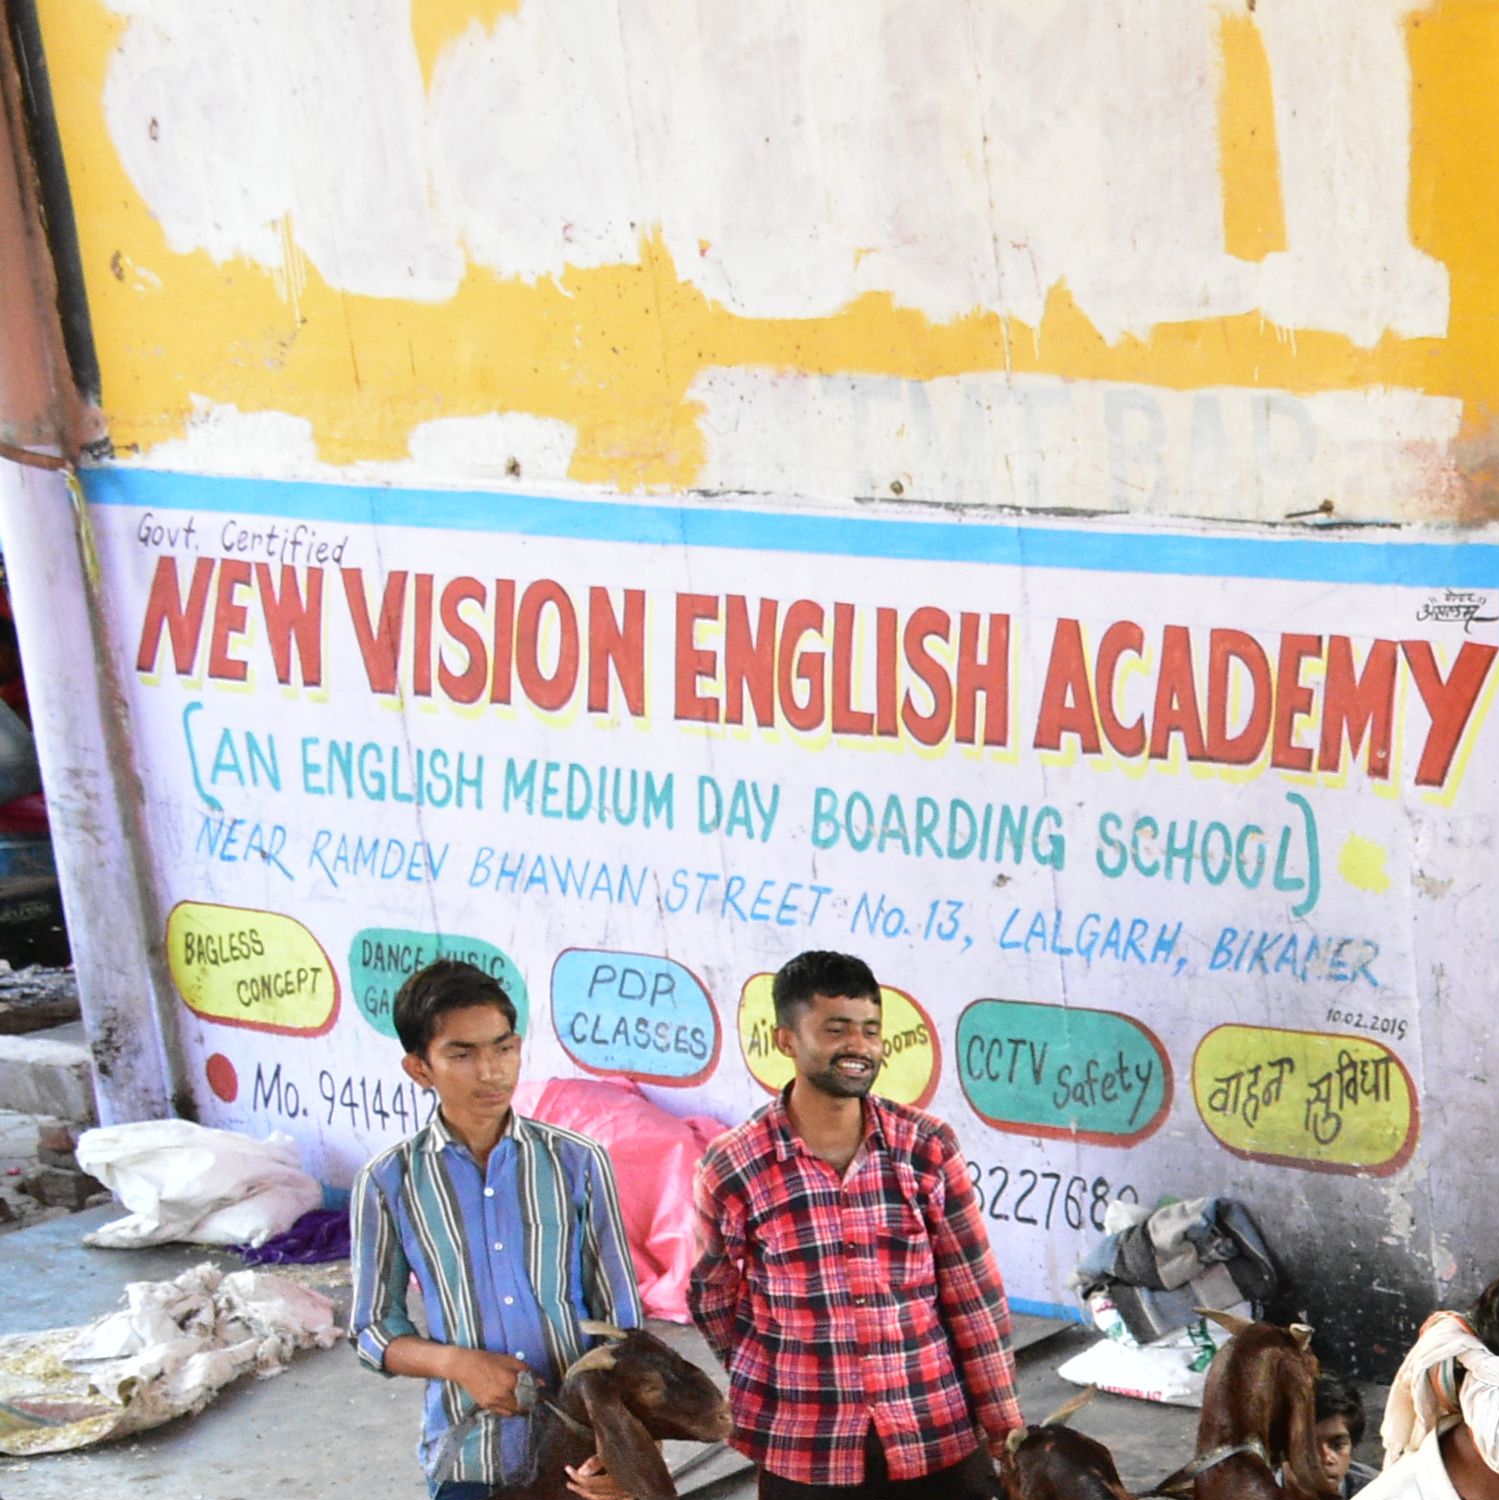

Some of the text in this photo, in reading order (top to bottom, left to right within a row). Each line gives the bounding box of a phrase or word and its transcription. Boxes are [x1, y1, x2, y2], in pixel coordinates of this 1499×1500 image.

[137, 512, 349, 566] Govt. Certified
[136, 556, 1499, 788] NEW VISION ENGLISH ACADEMY
[301, 736, 485, 809] ENGLISH
[503, 757, 675, 830] MEDIUM
[697, 774, 781, 843] DAY
[811, 786, 1066, 871] BOARDING
[196, 815, 295, 881] NEAR
[309, 829, 450, 888] RAMDEV
[468, 847, 648, 906] BHAWAN
[663, 869, 833, 927] STREET
[998, 907, 1190, 977] LALGARH,
[184, 929, 264, 966] BAGLESS
[362, 939, 426, 974] DANCE
[236, 967, 322, 1008] CONCEPT
[588, 964, 676, 1007] PDP
[570, 1012, 707, 1060] CLASSES
[880, 1023, 928, 1068] ooms
[253, 1062, 309, 1119] Mo.
[967, 1035, 1153, 1126] CCTV Safety
[1208, 1049, 1394, 1145] वाहन सुविधा
